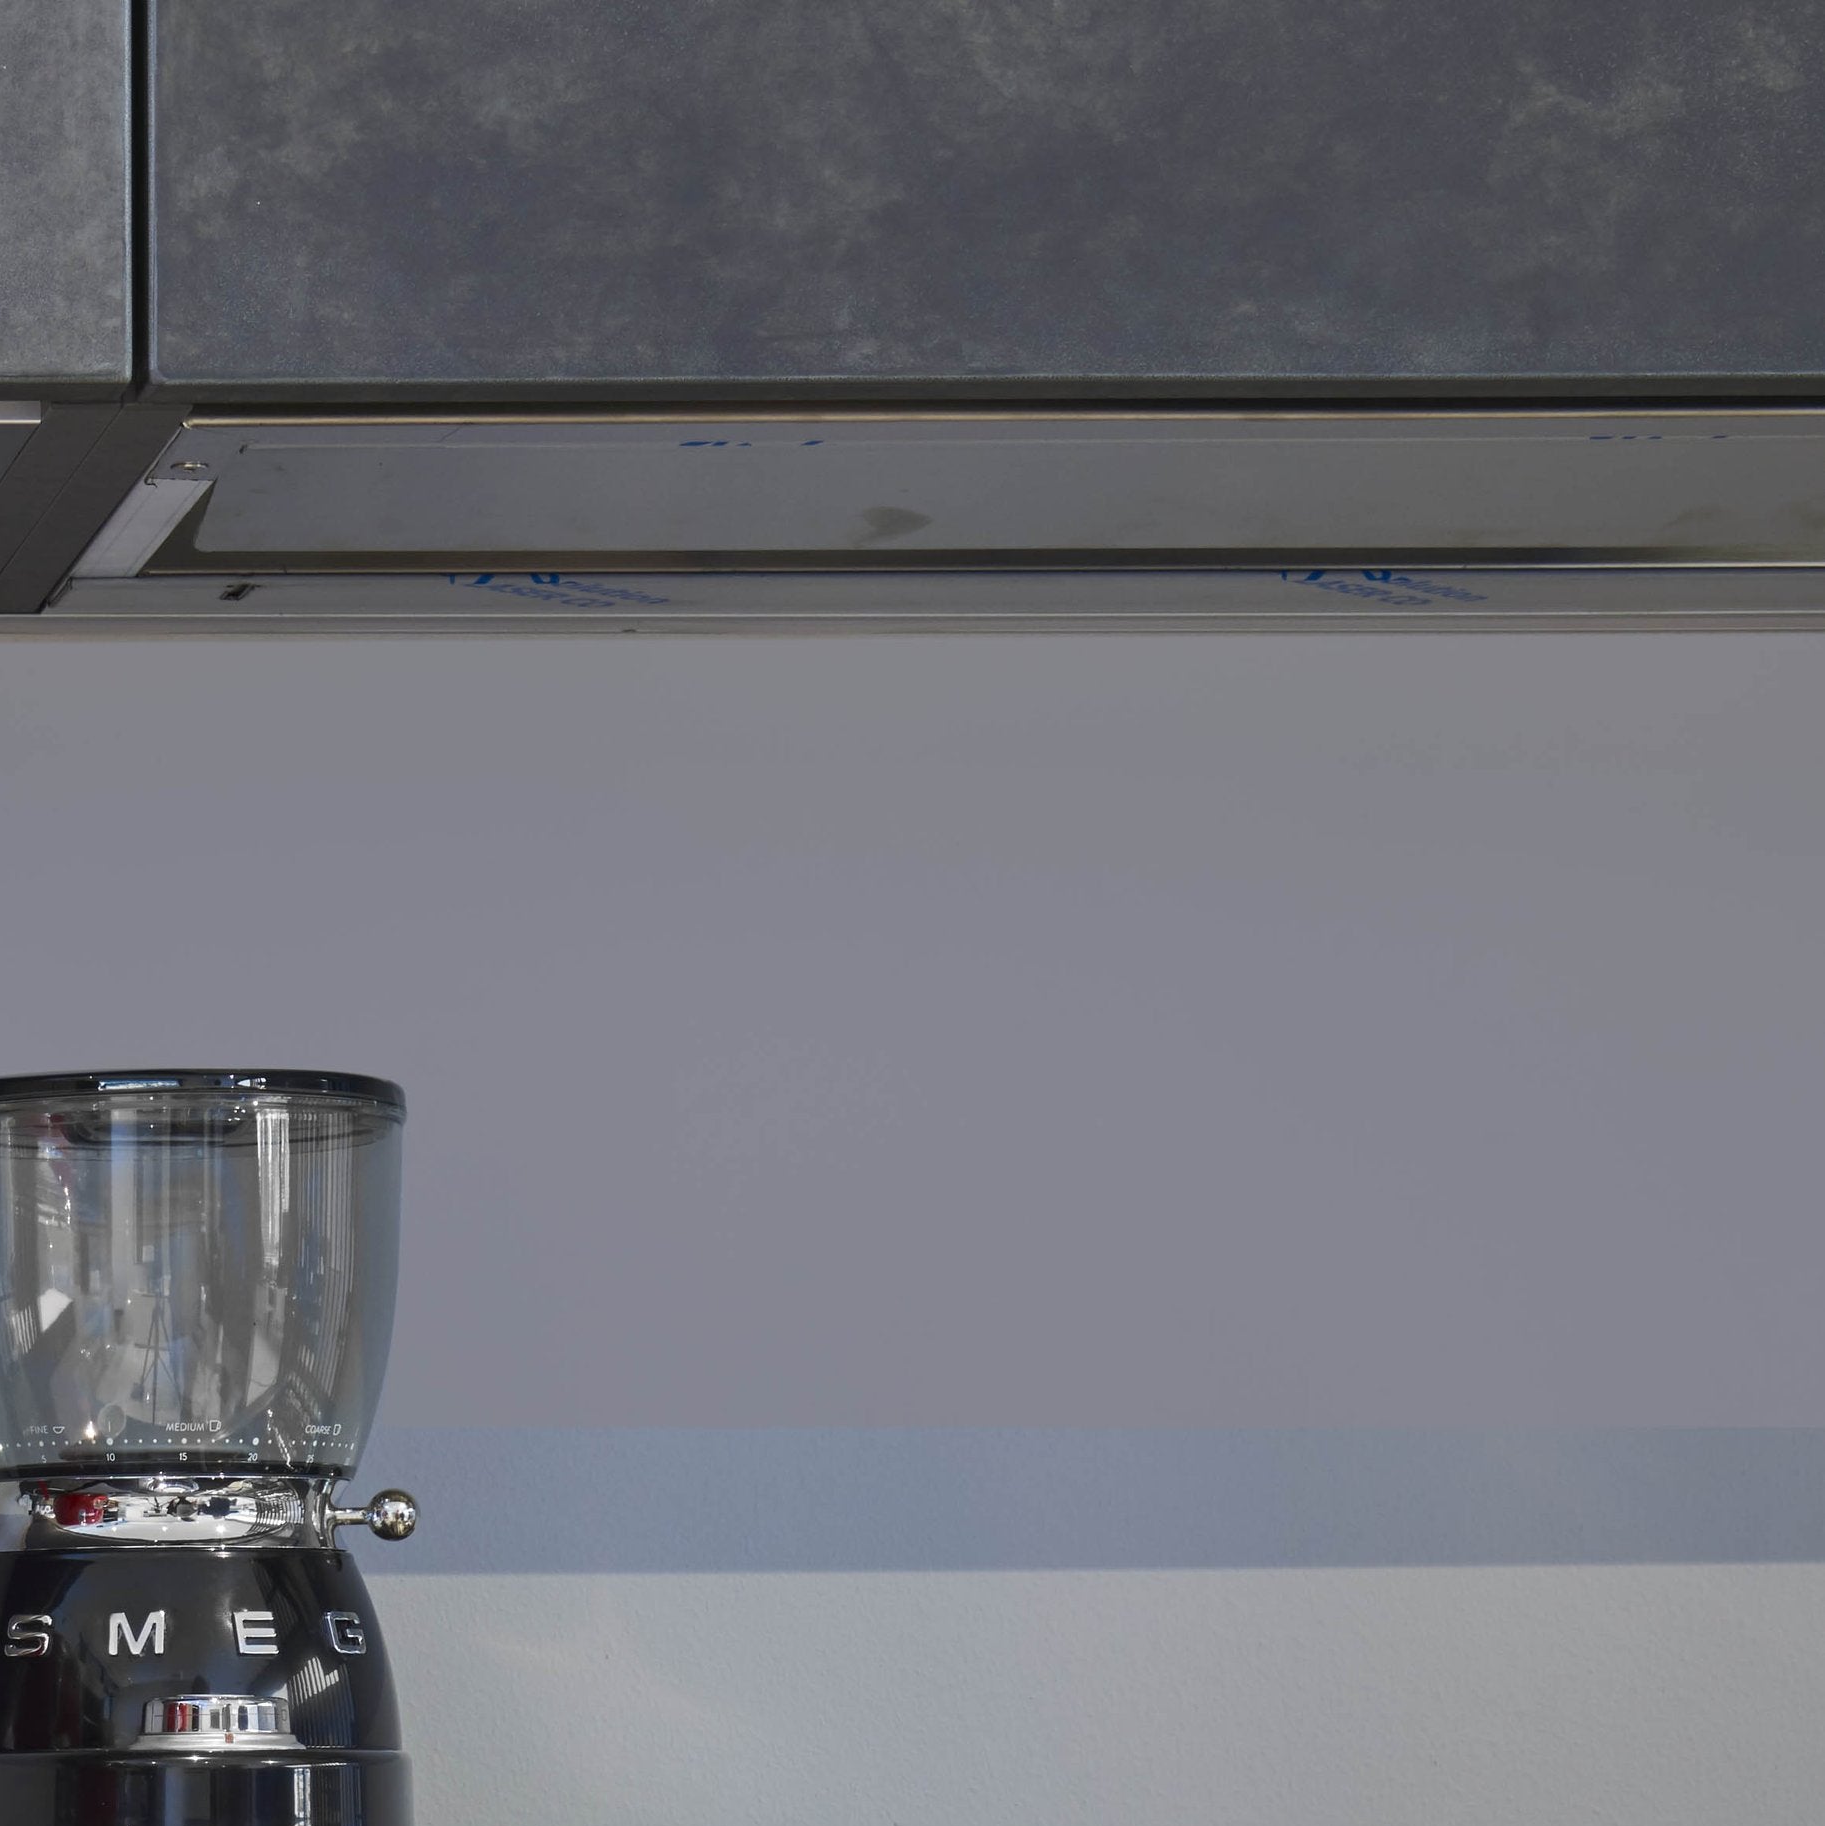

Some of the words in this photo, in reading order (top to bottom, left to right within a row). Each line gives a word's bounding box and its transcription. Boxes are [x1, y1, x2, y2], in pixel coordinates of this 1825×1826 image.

[165, 1423, 205, 1432] MEDIUM
[305, 1424, 331, 1435] COARSE
[41, 1454, 47, 1463] 5
[105, 1453, 116, 1462] 10
[179, 1452, 188, 1461] 15
[247, 1452, 258, 1462] 20
[4, 1610, 367, 1657] SMEG
